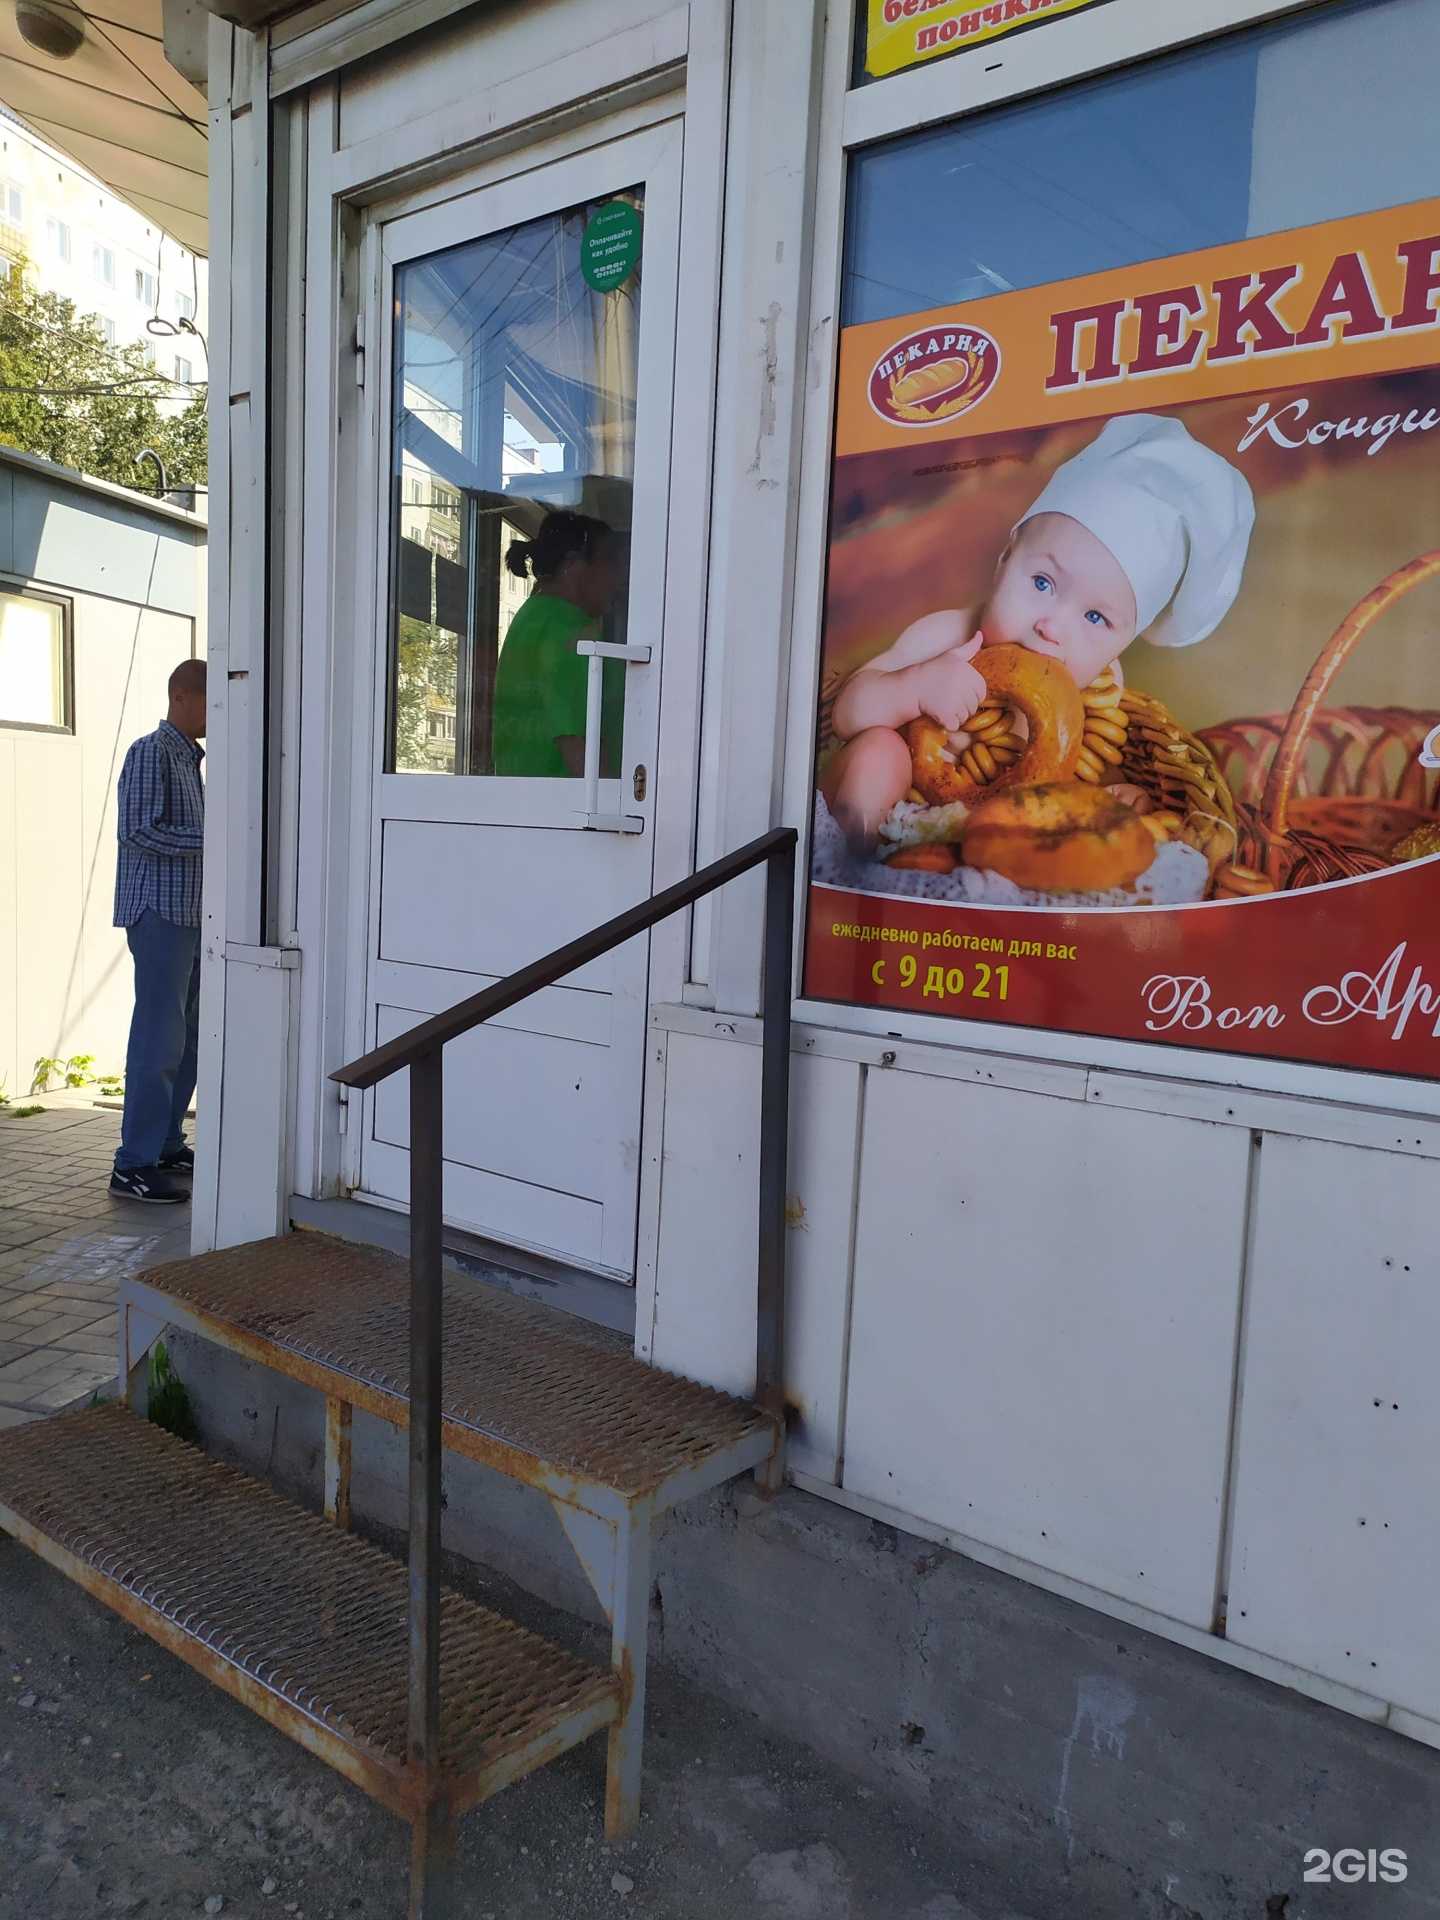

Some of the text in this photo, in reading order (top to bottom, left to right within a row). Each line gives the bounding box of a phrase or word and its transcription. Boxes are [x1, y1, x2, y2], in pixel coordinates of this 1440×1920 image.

[589, 229, 633, 248] Оплачивайте
[592, 241, 629, 258] как удобно
[1045, 235, 1440, 394] ПЕКАР
[877, 334, 990, 380] ПЕКАРНЯ
[831, 922, 1078, 961] ежедневно работаем для вас
[871, 954, 1009, 1000] с 9 до 21
[1140, 974, 1287, 1031] Bon
